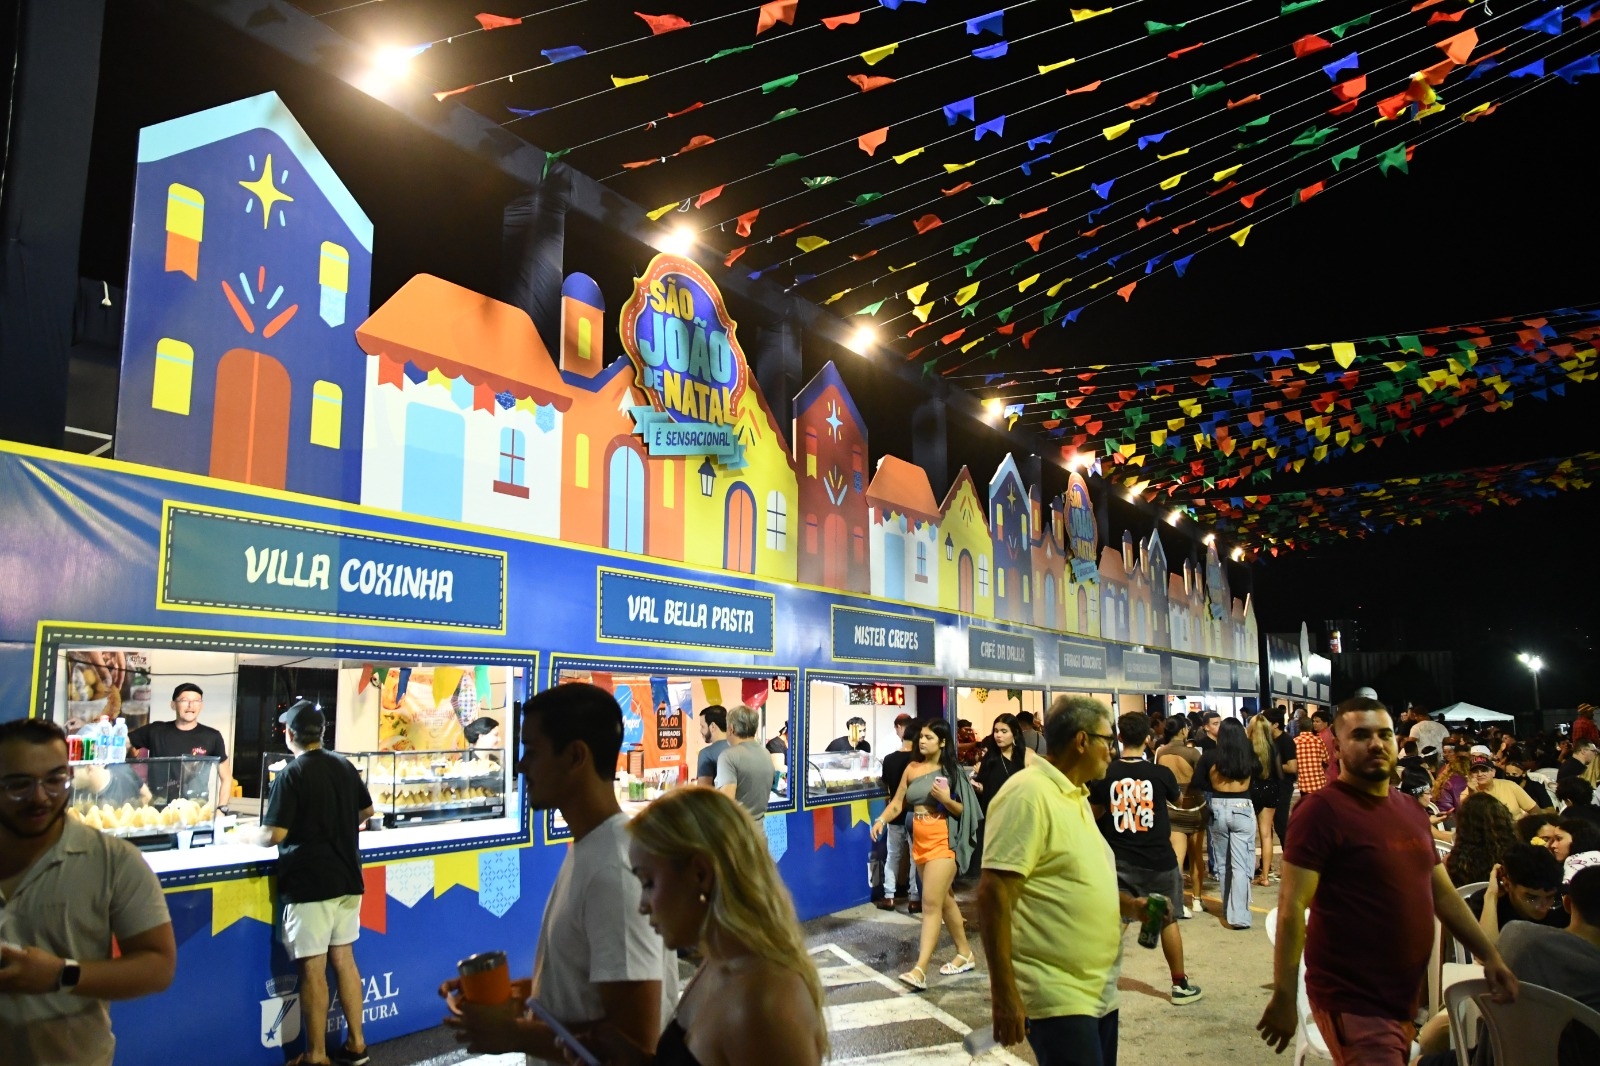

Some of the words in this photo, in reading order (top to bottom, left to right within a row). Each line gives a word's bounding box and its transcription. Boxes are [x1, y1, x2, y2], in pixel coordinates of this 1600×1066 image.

[650, 277, 695, 321] SÃO
[639, 312, 732, 384] JOÃO
[643, 366, 664, 392] DE
[663, 369, 740, 427] NATAL
[655, 427, 662, 446] É
[666, 431, 731, 447] SENSACIONAL
[245, 545, 331, 591] VILLA
[339, 557, 454, 604] COXINHA
[627, 594, 659, 624] VAL
[664, 599, 708, 630] BELLA
[711, 606, 755, 635] PASTA
[854, 625, 886, 649] MISTER
[888, 628, 919, 651] CREPES
[980, 640, 996, 659] CAFÉ
[997, 644, 1006, 660] DA
